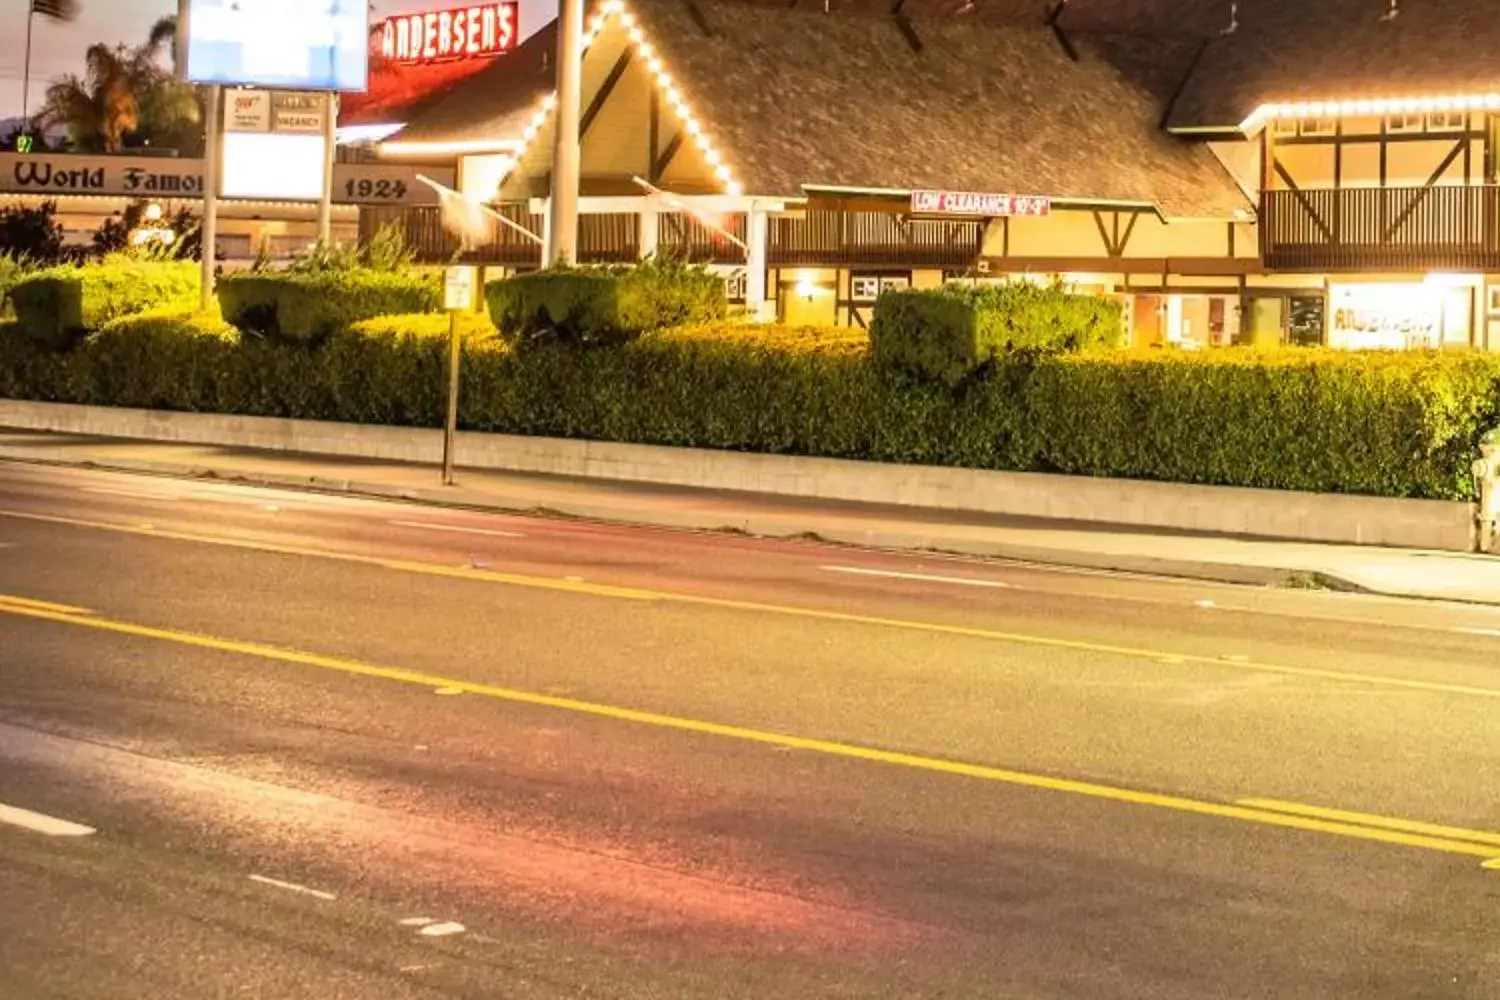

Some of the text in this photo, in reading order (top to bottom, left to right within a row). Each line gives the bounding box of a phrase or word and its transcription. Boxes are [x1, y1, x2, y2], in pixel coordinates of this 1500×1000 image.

[278, 116, 319, 127] VACANCY
[14, 161, 105, 188] World
[345, 178, 407, 199] 1924
[914, 190, 939, 210] LOW
[945, 193, 1008, 214] CLEARANCE
